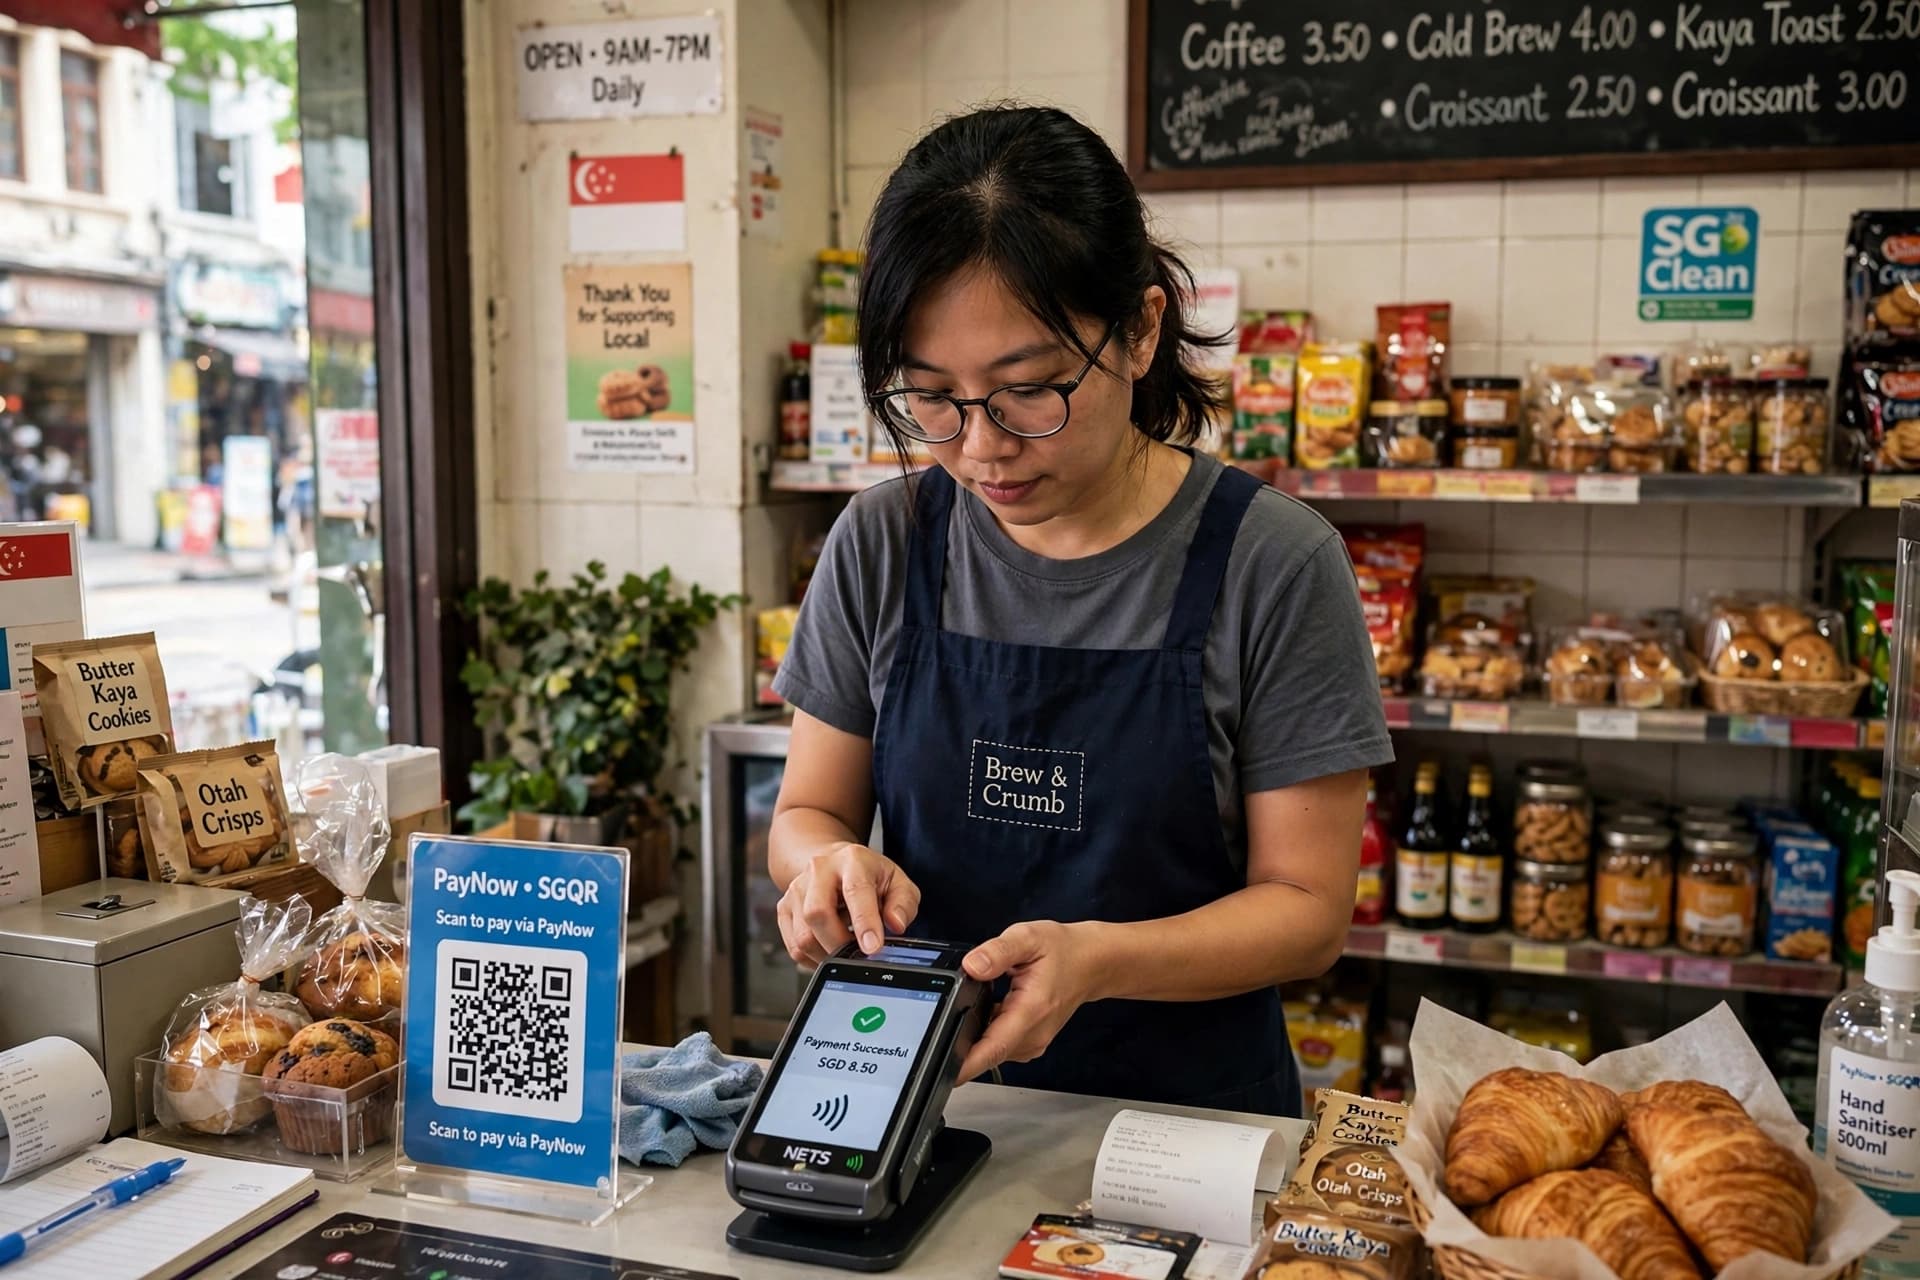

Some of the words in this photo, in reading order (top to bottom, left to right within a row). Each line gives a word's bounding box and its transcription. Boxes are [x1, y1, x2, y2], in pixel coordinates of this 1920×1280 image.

[1181, 22, 1286, 70] Coffee
[1303, 21, 1371, 66] 3.50
[1406, 13, 1474, 60] Cold
[1485, 9, 1561, 57] Brew
[1570, 6, 1638, 52] 4.00
[1675, 3, 1755, 66] Kaya
[1763, 2, 1844, 44] Toast
[1856, 0, 1920, 41] 2.50
[524, 42, 582, 71] OPEN
[592, 75, 645, 107] Daily
[1405, 82, 1549, 131] Croissant
[1566, 75, 1637, 119] 2.50
[1672, 71, 1821, 120] Croissant
[1835, 70, 1907, 113] 3.00
[1652, 214, 1721, 258] SG
[1645, 257, 1750, 291] Clean
[583, 284, 633, 304] Thank
[638, 284, 670, 303] You
[578, 307, 597, 323] for
[602, 307, 675, 327] Supporting
[604, 329, 649, 349] Local
[76, 661, 135, 681] Butter
[91, 683, 138, 706] Kaya
[88, 707, 151, 731] Cookies
[985, 755, 1045, 785] Brew
[1051, 765, 1068, 788] &
[198, 778, 248, 806] Otah
[983, 783, 1065, 814] Crumb
[202, 809, 264, 835] Crisps
[434, 867, 518, 898] PayNow
[537, 876, 599, 905] SGQR
[436, 910, 467, 927] Scan
[470, 912, 485, 928] to
[487, 916, 512, 935] pay
[515, 916, 535, 934] via
[537, 918, 595, 939] PayNow
[804, 1035, 851, 1051] Payment
[852, 1042, 909, 1058] Successful
[818, 1056, 846, 1070] SGD
[848, 1061, 878, 1074] 8.50
[1346, 1103, 1403, 1123] Butter
[1840, 1089, 1884, 1114] Hand
[1333, 1128, 1400, 1147] Cookies
[1839, 1109, 1916, 1139] Sanitiser
[429, 1121, 461, 1141] Scan
[463, 1126, 478, 1142] to
[480, 1130, 505, 1149] pay
[507, 1131, 528, 1149] via
[530, 1135, 586, 1157] PayNow
[1837, 1129, 1887, 1156] 500ml
[783, 1145, 832, 1165] NETS
[1346, 1162, 1387, 1183] Otah
[1317, 1178, 1352, 1194] Otah
[1358, 1185, 1403, 1207] Crisps
[1277, 1222, 1338, 1240] Butter
[1343, 1229, 1390, 1256] Kaya
